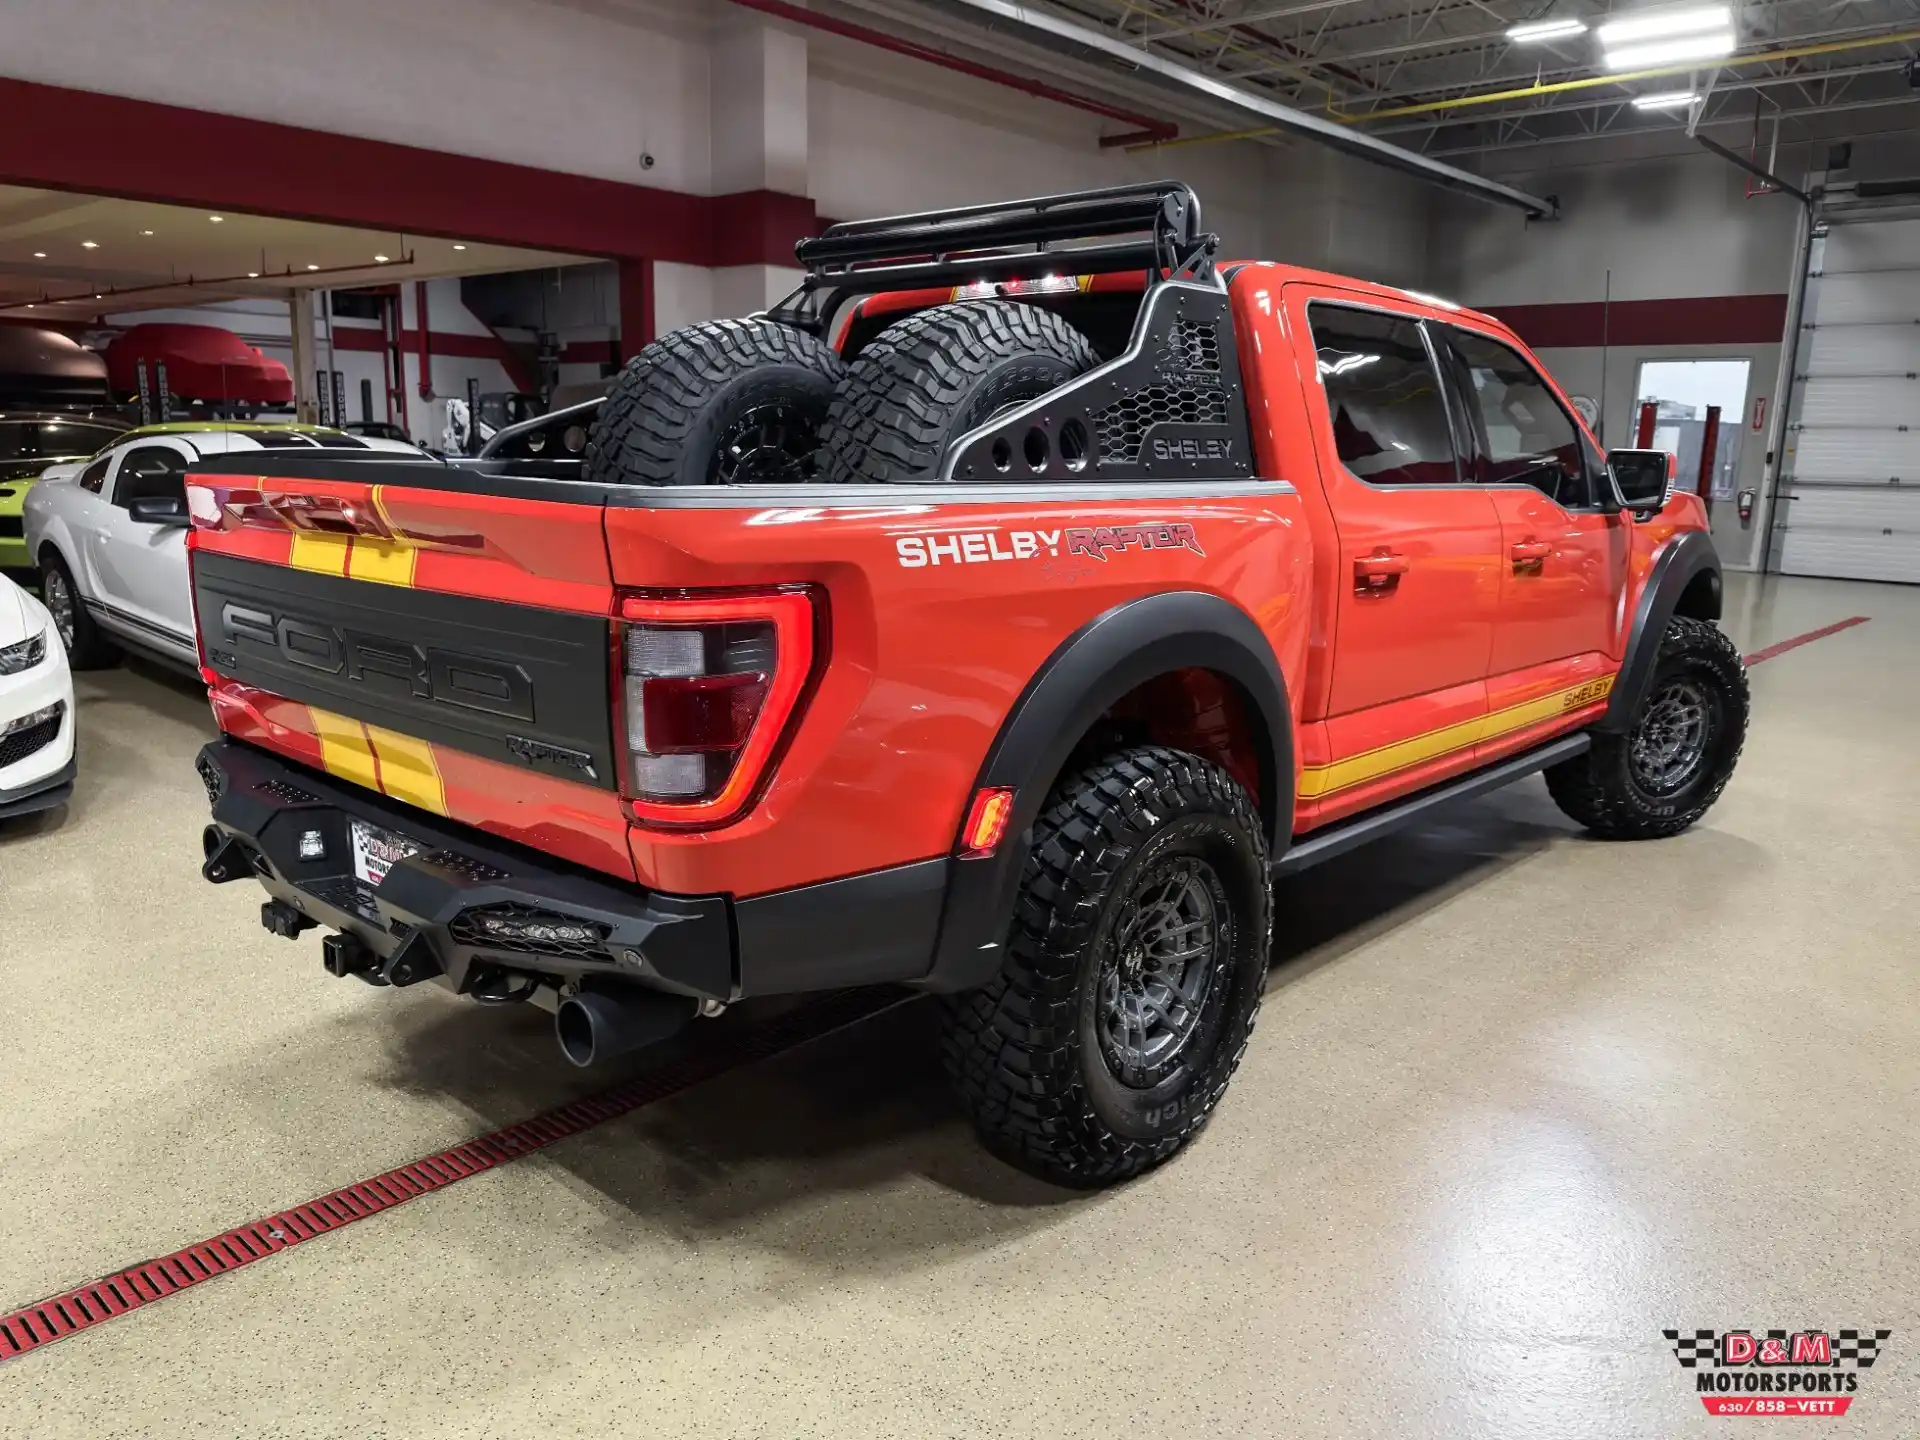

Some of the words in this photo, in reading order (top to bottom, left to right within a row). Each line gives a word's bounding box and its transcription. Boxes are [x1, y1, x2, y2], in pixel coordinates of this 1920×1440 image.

[1153, 438, 1233, 460] SHELBY
[896, 531, 1061, 567] SHELBY
[1065, 523, 1206, 562] RAPTOR
[221, 600, 536, 723] FORD
[1563, 680, 1612, 707] SHELBY
[505, 733, 599, 780] RAPTOR
